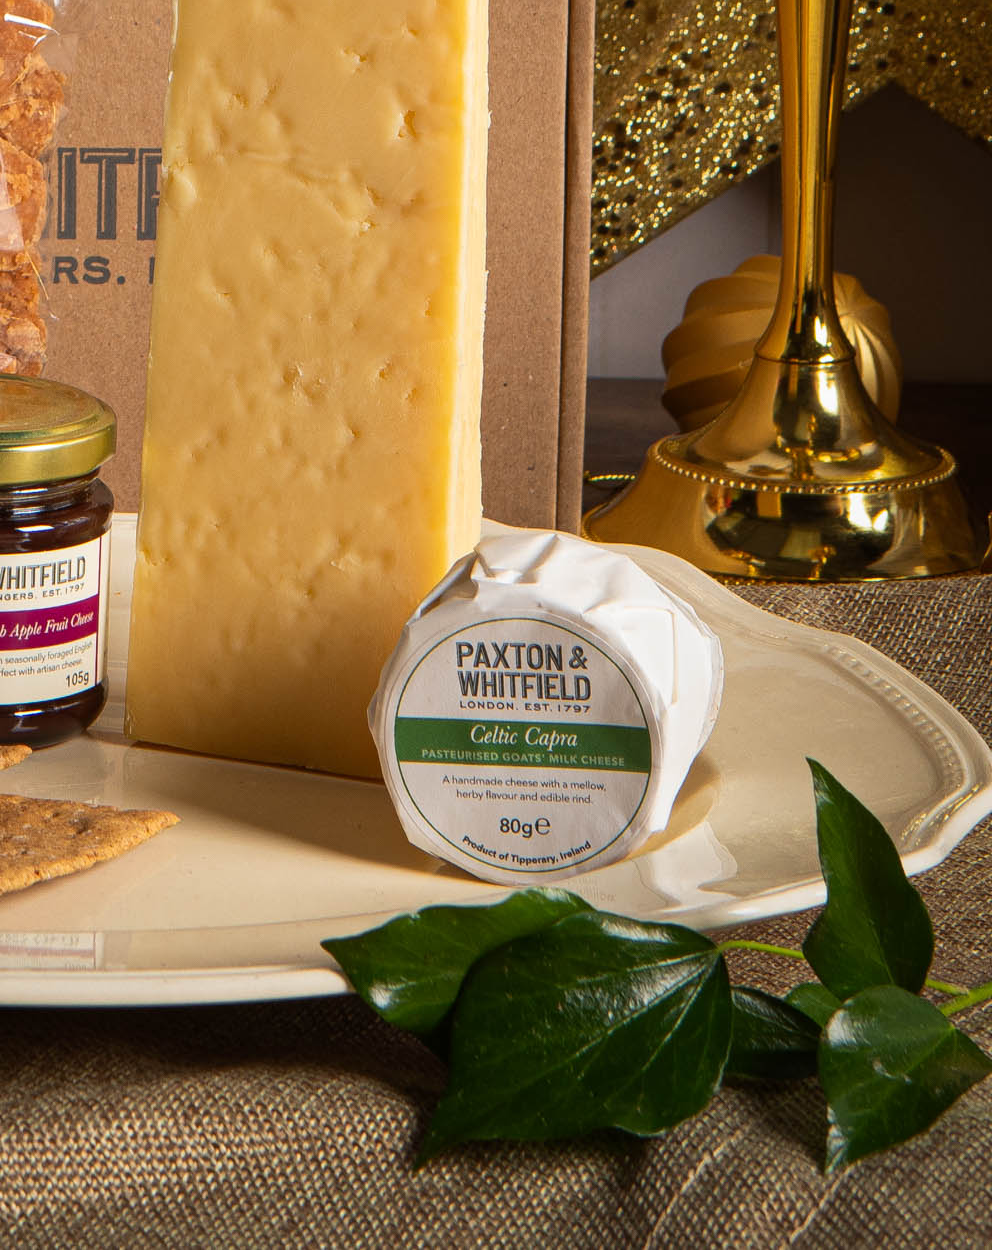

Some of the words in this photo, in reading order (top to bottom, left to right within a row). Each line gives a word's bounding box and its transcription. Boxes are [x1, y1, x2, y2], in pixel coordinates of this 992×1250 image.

[42, 587, 62, 598] EST.
[65, 582, 85, 595] 1797
[9, 622, 42, 641] Apple
[44, 616, 69, 634] Fruit
[70, 610, 94, 629] Cheese
[4, 653, 46, 666] seasonally
[47, 647, 73, 662] foraged
[73, 640, 93, 657] English
[456, 641, 563, 671] PAXTON
[568, 645, 588, 670] &
[18, 665, 36, 677] with
[36, 662, 61, 674] artisan
[65, 670, 90, 688] 105g
[457, 671, 591, 701] WHITFIELD
[459, 701, 519, 711] LONDON.
[525, 702, 553, 713] EST.
[558, 704, 591, 713] 1797
[470, 724, 518, 746] Celtic
[525, 725, 579, 752] Capra
[421, 749, 499, 762] PASTEURISED
[549, 753, 578, 765] MILK
[581, 755, 625, 767] CHEESE
[441, 775, 450, 785] A
[451, 775, 504, 787] handmade
[505, 778, 539, 788] cheese
[540, 778, 560, 789] with
[562, 781, 569, 789] a
[571, 779, 607, 792] mellow,
[456, 789, 483, 802] herby
[485, 790, 518, 802] flavour
[520, 792, 538, 802] and
[540, 792, 570, 803] edible
[572, 793, 594, 804] rind.
[462, 835, 498, 859] Product
[498, 852, 510, 862] of
[559, 840, 592, 862] Ireland
